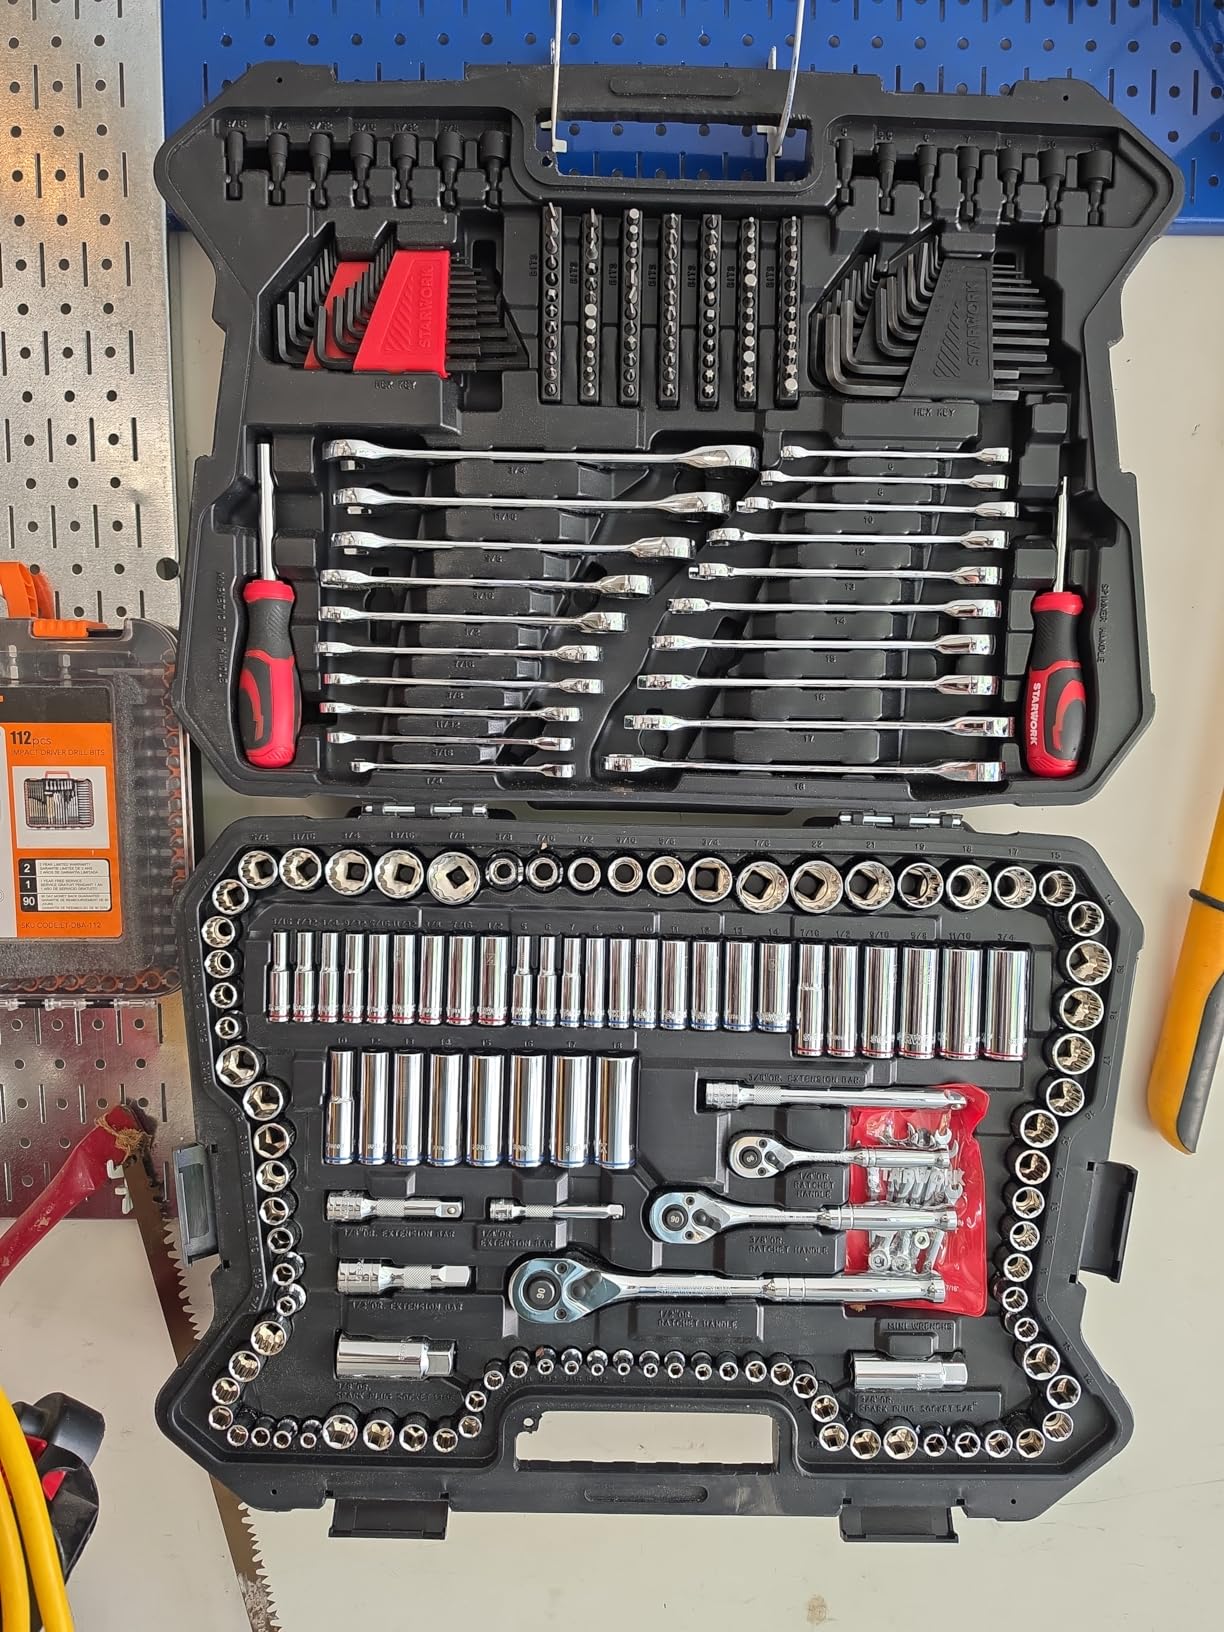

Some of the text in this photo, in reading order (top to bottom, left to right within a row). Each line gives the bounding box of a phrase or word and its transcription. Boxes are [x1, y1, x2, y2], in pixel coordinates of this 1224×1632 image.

[418, 264, 434, 348] STARWORK
[966, 280, 982, 367] STARWORK
[1096, 583, 1110, 663] SPINNER HANDLE
[1029, 682, 1041, 746] STARWORK
[24, 864, 31, 873] 2
[26, 880, 31, 889] 1
[23, 896, 36, 906] 90
[788, 1074, 838, 1084] EXTENSION
[793, 1180, 835, 1189] RATCHET
[796, 1190, 833, 1199] HANDLE
[670, 1215, 680, 1223] 90
[382, 1229, 433, 1238] EXTENSION
[480, 1239, 531, 1248] EXTENSION
[749, 1245, 829, 1255] RATCHET HANDLE
[536, 1287, 546, 1300] 90
[390, 1301, 442, 1311] EXTENSION
[657, 1319, 738, 1329] RATCHET HANDLE
[887, 1322, 908, 1331] MINI
[860, 1404, 889, 1413] SPARK
[892, 1404, 916, 1413] PLUG
[920, 1404, 954, 1413] SOCKET
